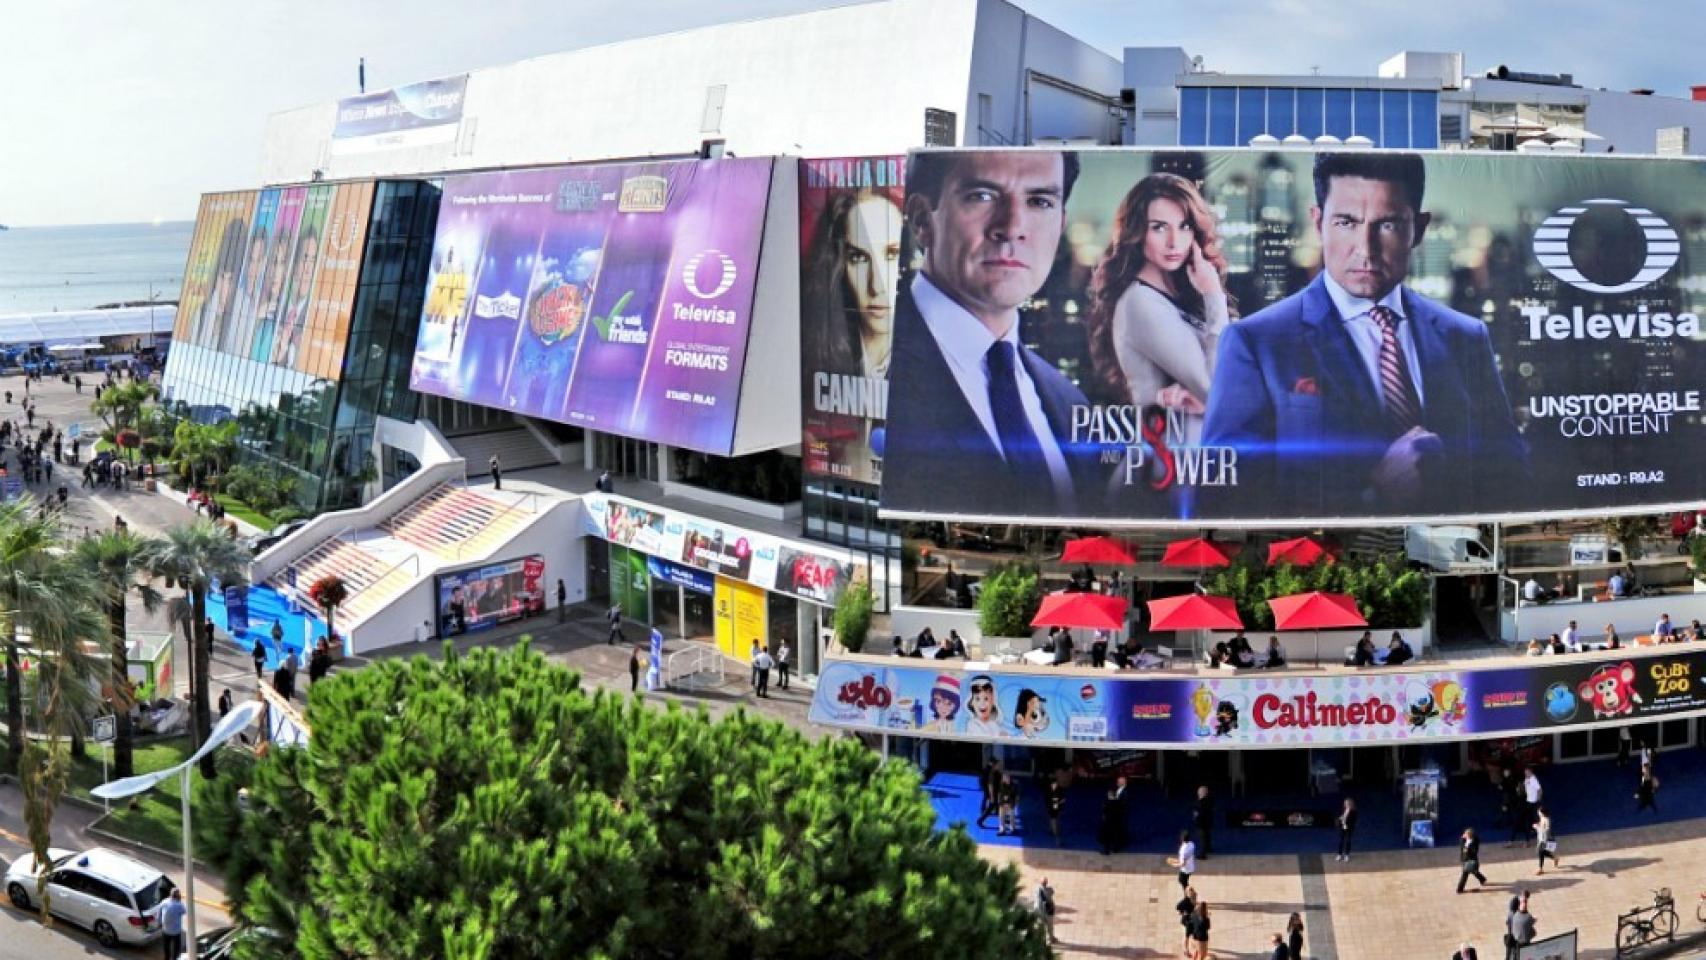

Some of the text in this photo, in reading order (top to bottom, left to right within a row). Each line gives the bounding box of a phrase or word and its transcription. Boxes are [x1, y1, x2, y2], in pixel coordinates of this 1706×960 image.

[807, 159, 873, 189] NATALIA
[602, 191, 616, 201] and
[672, 302, 737, 325] Televisa
[1521, 304, 1701, 341] Televisa
[608, 322, 649, 344] friends
[664, 349, 729, 372] FORMATS
[1529, 390, 1701, 418] UNSTOPPABLE
[1560, 413, 1673, 438] CONTENT
[1101, 449, 1121, 464] AND
[1629, 470, 1665, 484] R9.A2
[791, 557, 838, 590] FEAR
[1252, 690, 1397, 729] Calimero
